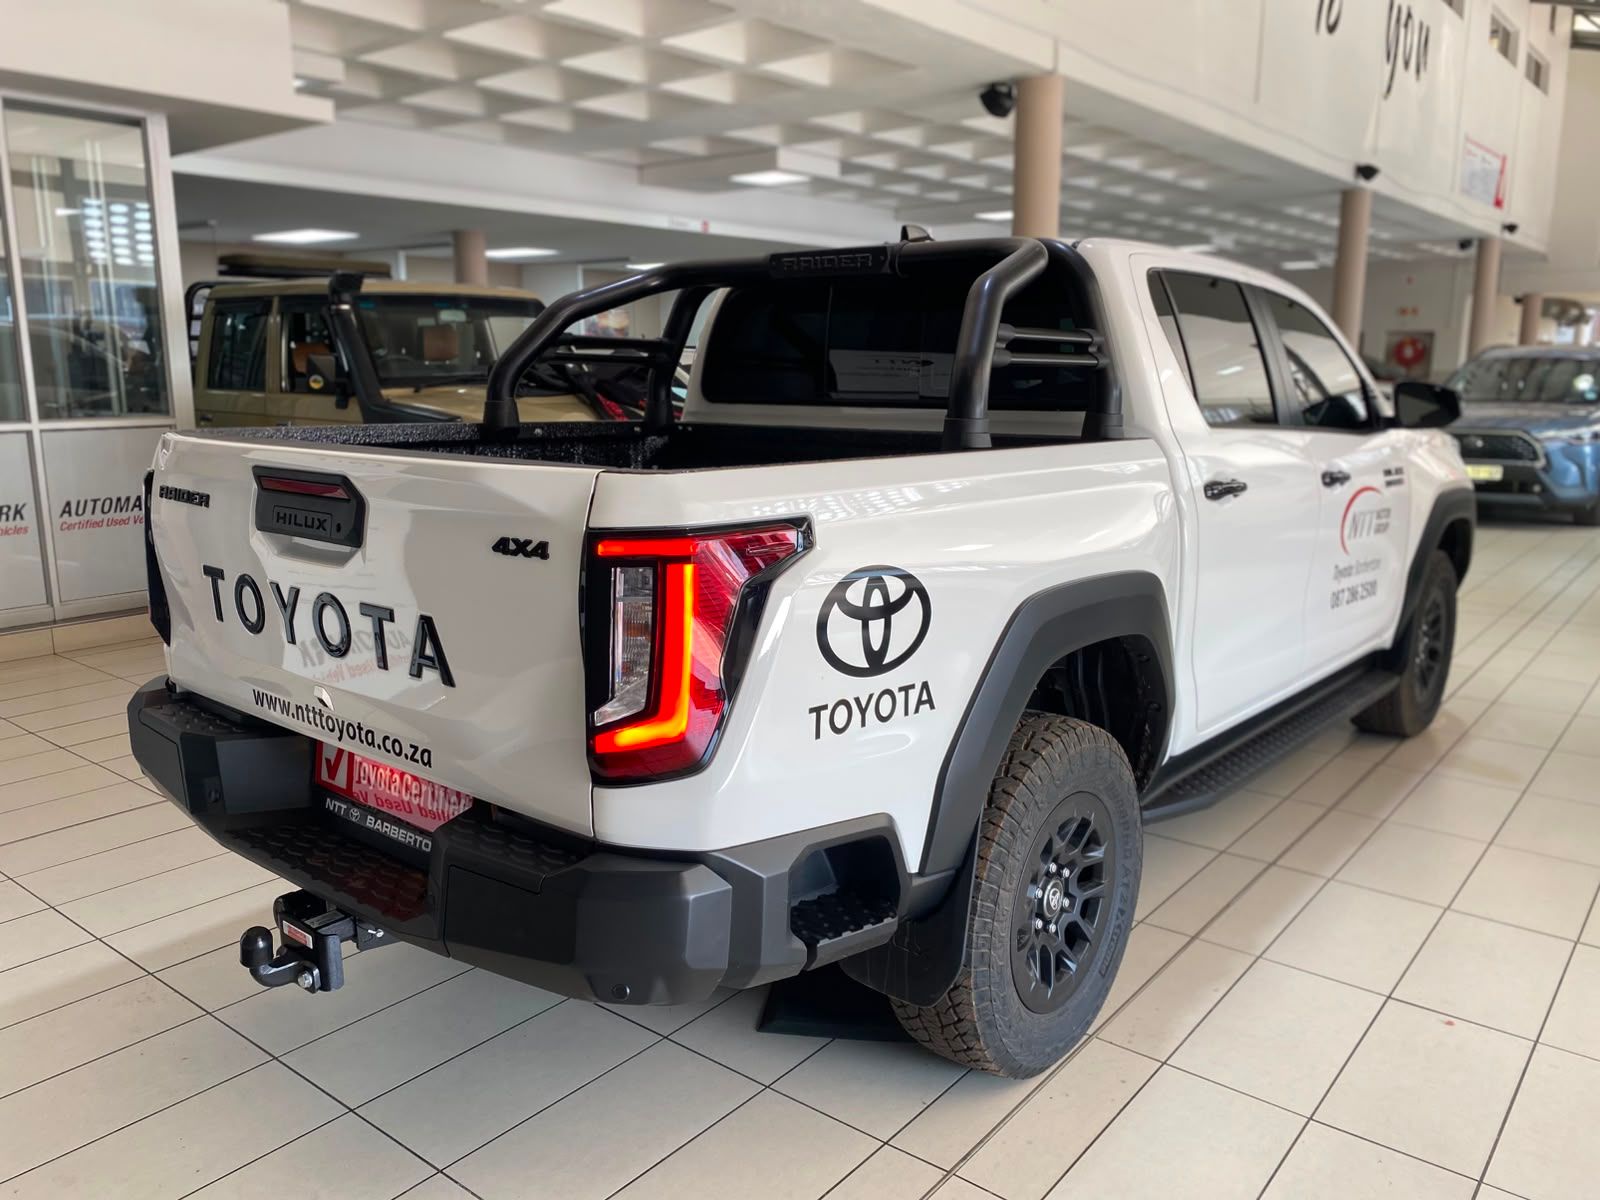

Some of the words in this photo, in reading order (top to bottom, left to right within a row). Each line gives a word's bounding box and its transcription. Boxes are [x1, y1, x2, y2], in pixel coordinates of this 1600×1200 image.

[782, 252, 872, 272] RAIDER
[159, 485, 210, 508] RAIDER
[59, 519, 104, 532] Certified
[106, 517, 130, 527] Used
[276, 511, 328, 533] HILUX
[202, 564, 456, 689] TOYOTA
[252, 688, 433, 770] www.ntttoyota.co.za
[808, 680, 936, 741] TOYOTA
[353, 756, 401, 797] Toyota
[325, 797, 347, 817] NTT
[366, 814, 433, 853] BARBERTO
